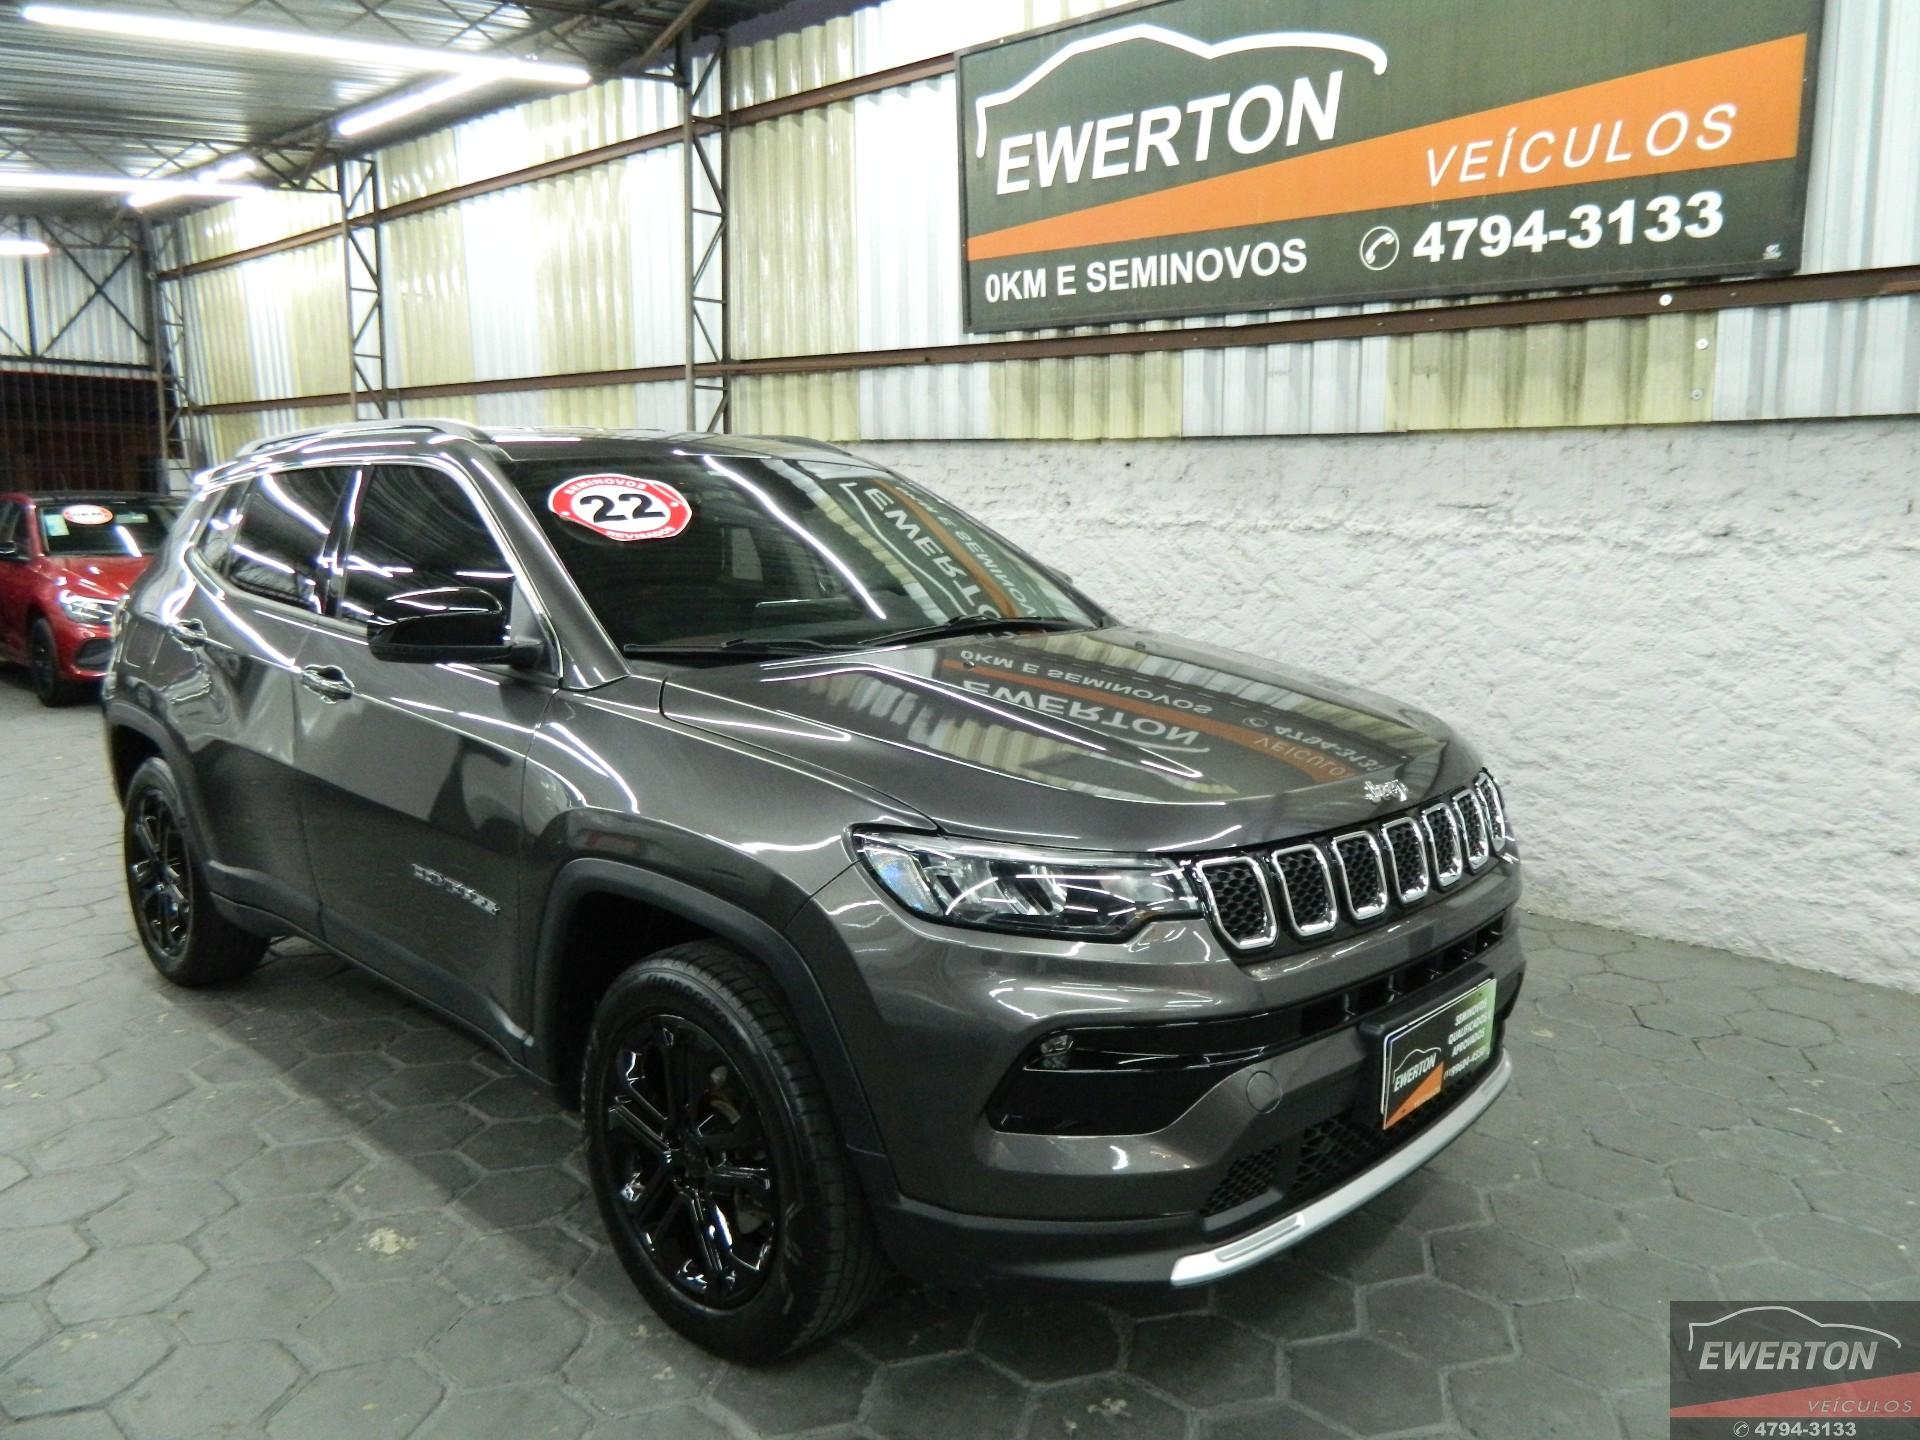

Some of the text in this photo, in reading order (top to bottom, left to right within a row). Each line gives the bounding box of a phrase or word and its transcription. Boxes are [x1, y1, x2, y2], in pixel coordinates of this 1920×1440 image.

[996, 70, 1343, 195] EWERTON
[1426, 104, 1738, 187] VEÍCULOS
[1412, 190, 1725, 263] 4794-3133
[985, 238, 1308, 303] 0KM E SEMINOVOS
[563, 478, 647, 496] SEMINOVOS
[579, 493, 667, 523] 22
[1393, 1053, 1437, 1092] EWERTON
